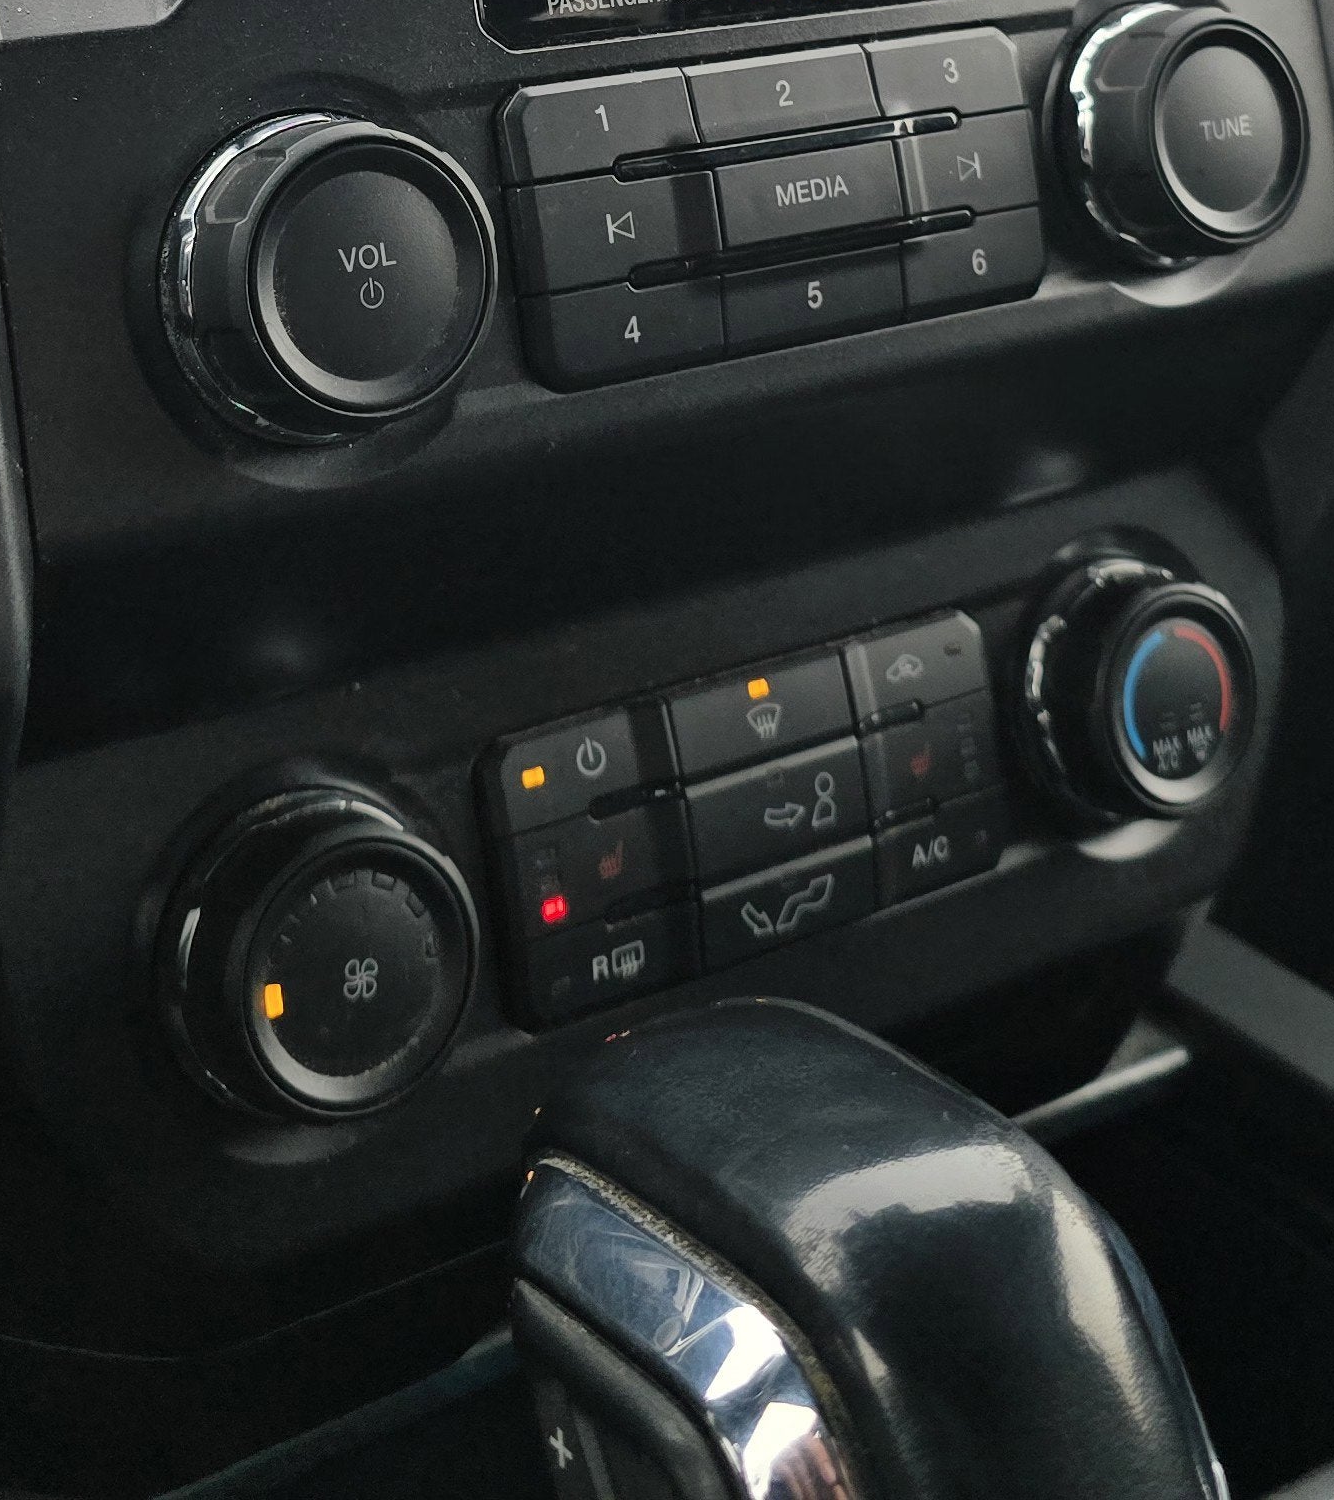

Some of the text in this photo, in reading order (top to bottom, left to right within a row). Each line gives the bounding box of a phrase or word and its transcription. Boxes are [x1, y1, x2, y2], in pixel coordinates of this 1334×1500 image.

[942, 58, 960, 84] 3
[775, 79, 794, 107] 2
[595, 104, 611, 132] 1
[1199, 114, 1253, 142] TUNE
[775, 175, 850, 207] MEDIA
[337, 243, 397, 273] VOL
[971, 248, 988, 276] 6
[806, 280, 823, 309] 5
[624, 315, 641, 344] 4
